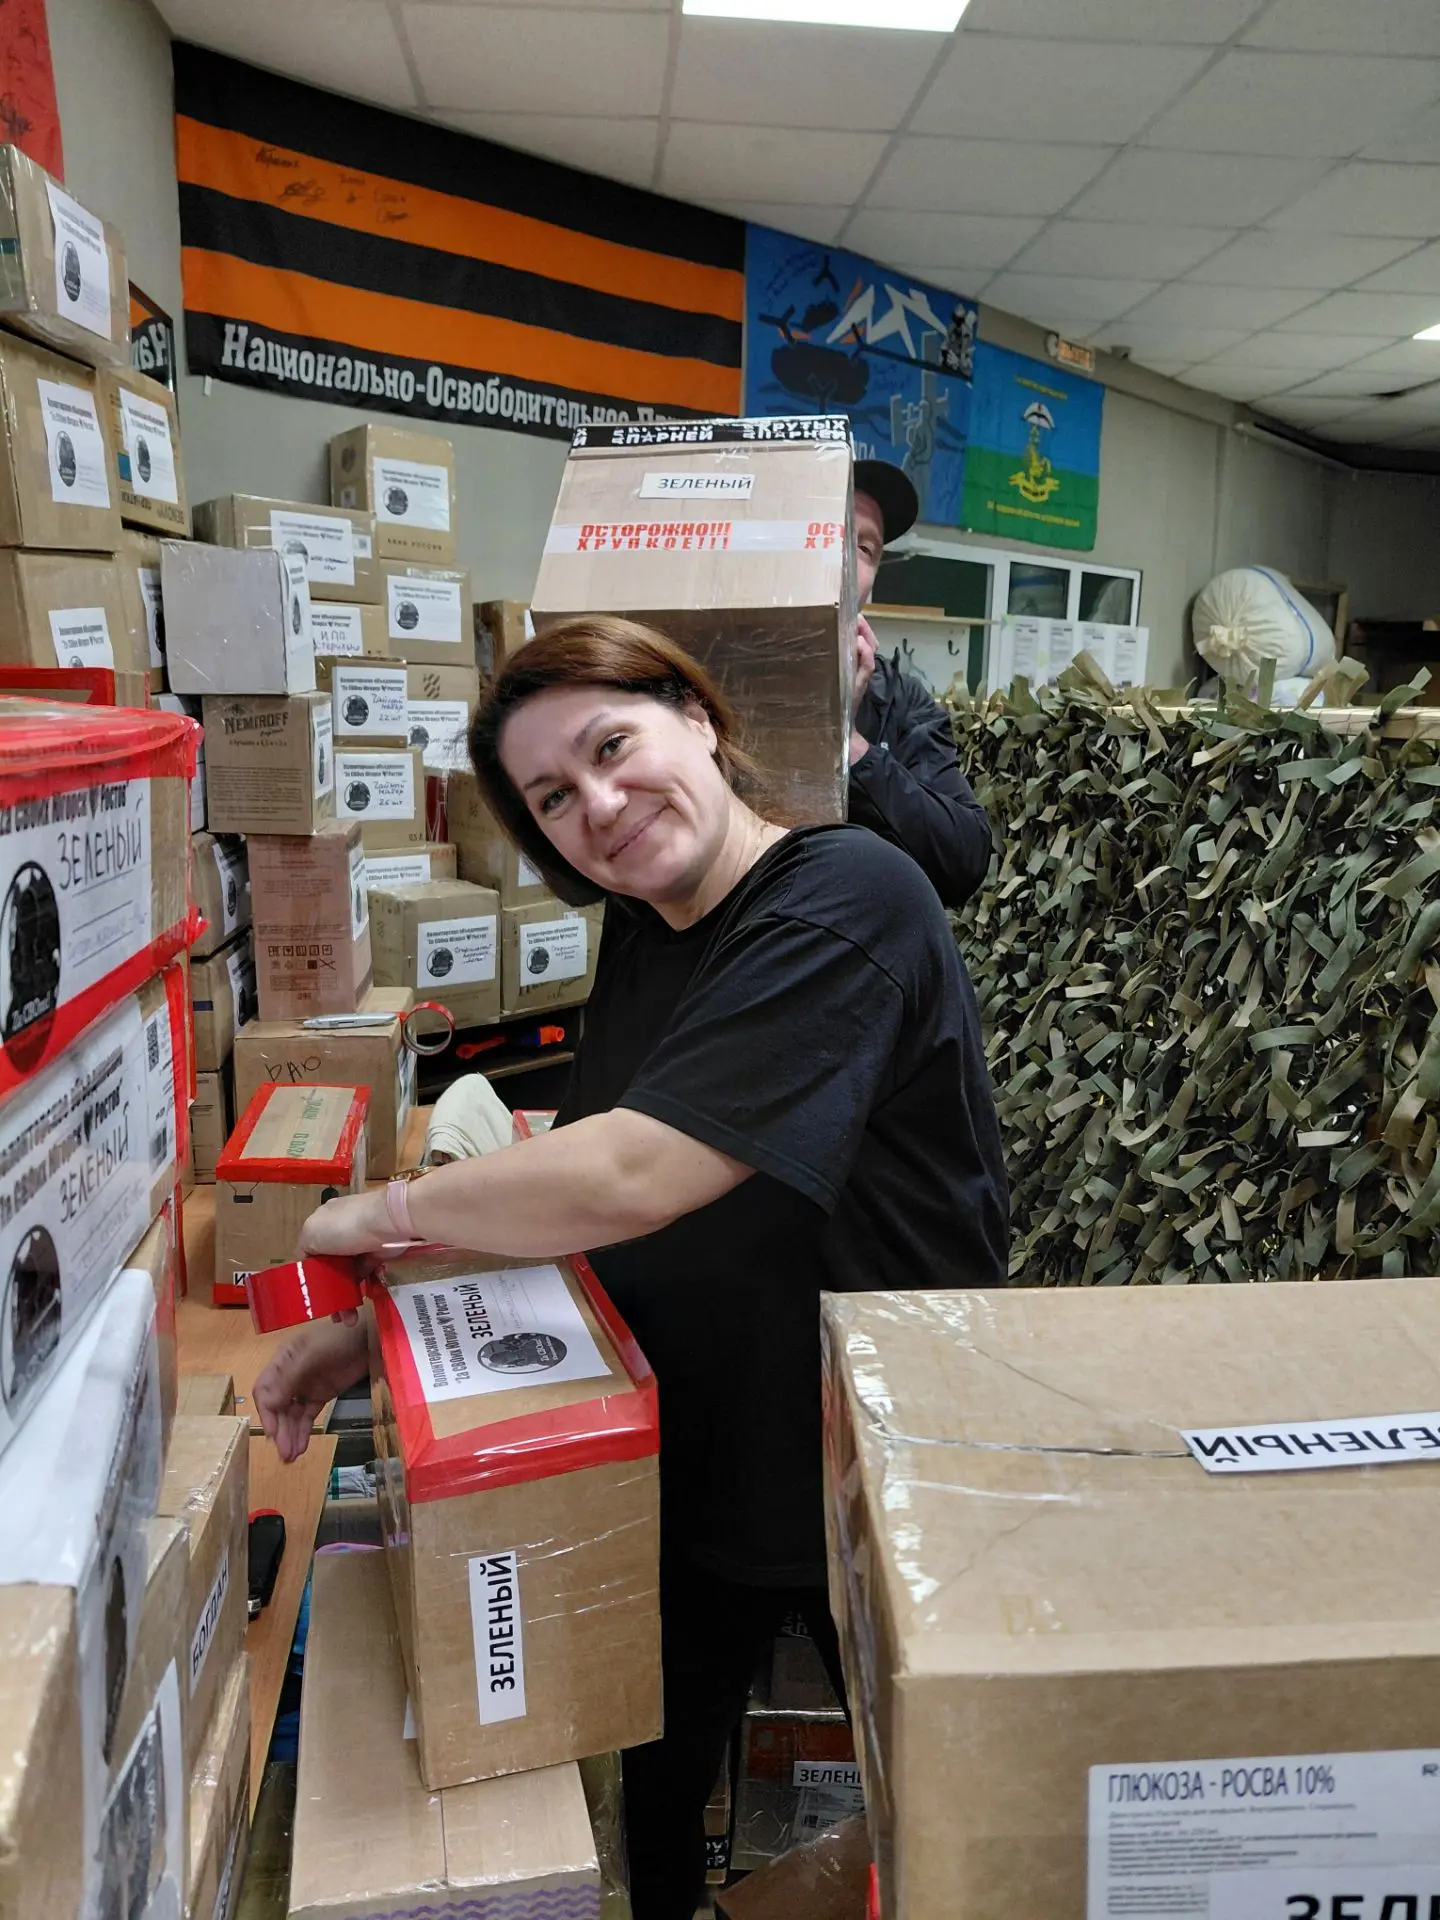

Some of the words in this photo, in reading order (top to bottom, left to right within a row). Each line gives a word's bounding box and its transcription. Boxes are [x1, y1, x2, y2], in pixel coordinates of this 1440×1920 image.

[658, 476, 751, 489] ЗЕЛЕНЫЙ
[577, 537, 728, 550] ХРУПКОЕ!!!
[580, 523, 731, 537] ОСТОРОЖНО!!!
[224, 711, 289, 735] NEMIROFF
[412, 1293, 433, 1337] объединение
[453, 1282, 493, 1340] ЗЕЛЕНЫЙ
[423, 1335, 449, 1389] Волонтерское
[1192, 1427, 1440, 1464] ЕЛЕНЫЙ
[192, 1559, 228, 1677] БОГДАН
[479, 1555, 515, 1693] ЗЕЛЕНЫЙ
[1108, 1771, 1205, 1803] ГЛЮКОЗА
[1221, 1766, 1289, 1799] РОСВА
[1295, 1764, 1335, 1795] 10%
[1286, 1894, 1440, 1920] ЗЕЛ
